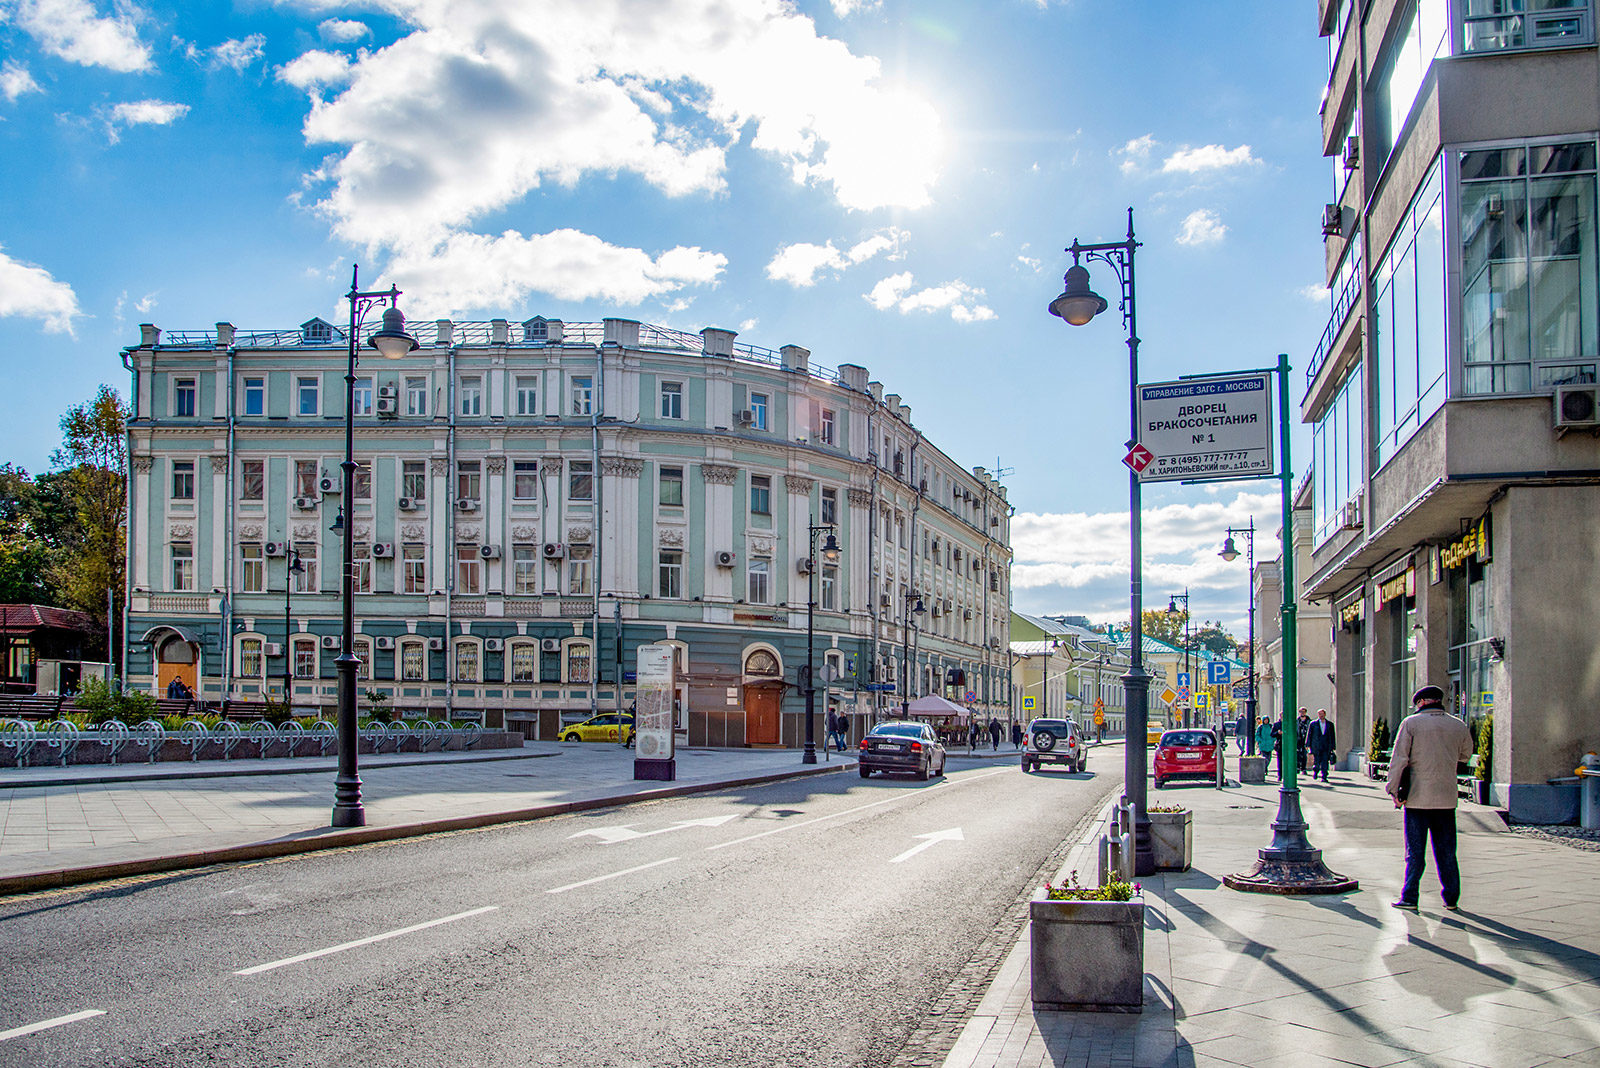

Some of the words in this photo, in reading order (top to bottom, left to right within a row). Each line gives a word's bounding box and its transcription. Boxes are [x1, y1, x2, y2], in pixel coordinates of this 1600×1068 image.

[1145, 387, 1195, 399] УПРАВЛЕНИЕ
[1196, 385, 1216, 394] ЗАГС
[1225, 381, 1261, 392] МОСКВЫ
[1178, 403, 1227, 417] ДВОРЕЦ
[1149, 413, 1258, 431] БРАКОСОЧЕТАНИЯ
[1192, 434, 1205, 444] №
[1207, 433, 1216, 443] 1
[1170, 457, 1177, 466] 8
[1178, 455, 1202, 465] (495)
[1203, 451, 1248, 463] 777-77-77
[1149, 467, 1158, 476] М.
[1158, 462, 1219, 476] ХАРИТОНЬЕВСКИЙ
[1214, 664, 1227, 682] P
